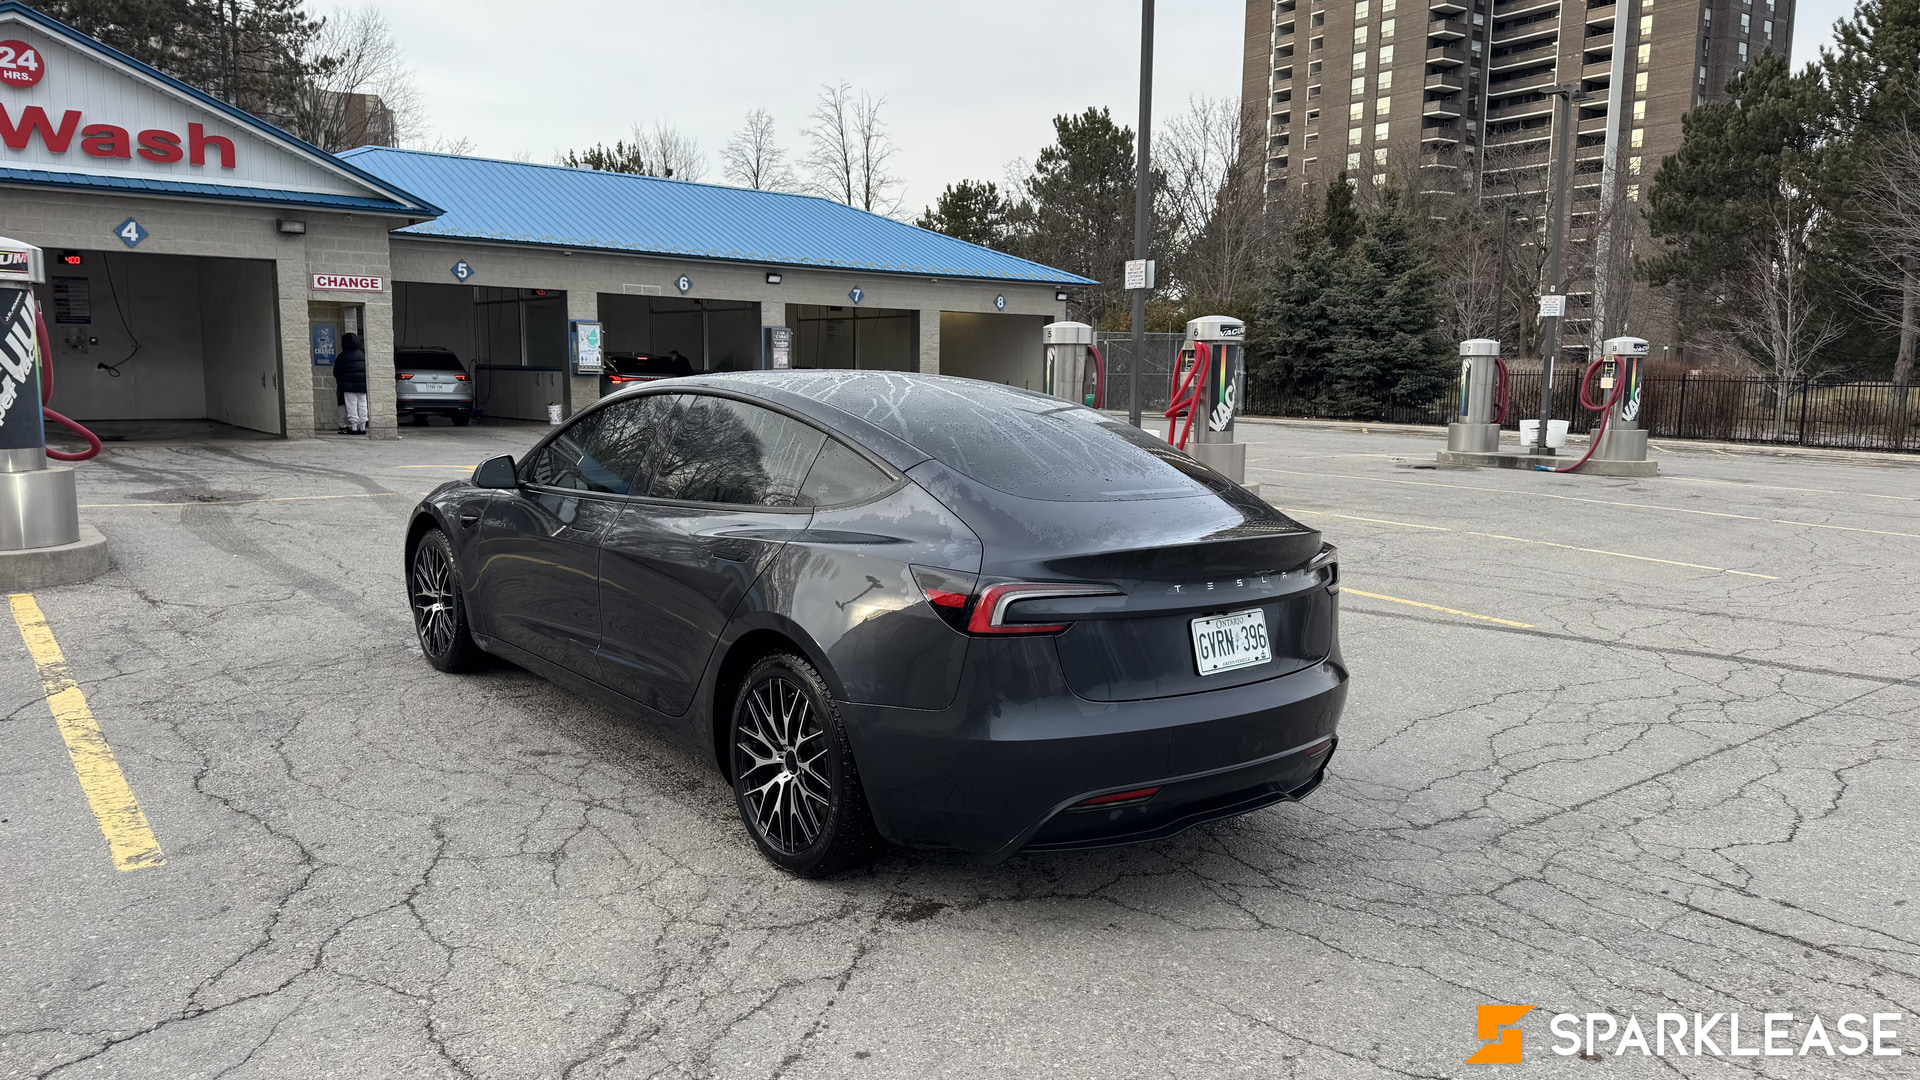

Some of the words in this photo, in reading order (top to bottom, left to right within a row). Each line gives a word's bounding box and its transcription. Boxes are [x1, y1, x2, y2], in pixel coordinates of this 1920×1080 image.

[0, 46, 38, 71] 24
[3, 70, 33, 81] HRS.
[0, 103, 236, 169] Wash
[121, 221, 138, 242] 4
[458, 263, 467, 278] 5
[317, 276, 379, 289] CHANGE
[679, 276, 688, 290] 6
[853, 289, 860, 302] 7
[997, 297, 1004, 308] 8
[1194, 329, 1199, 337] 6
[1174, 572, 1288, 593] TESLA
[1199, 628, 1235, 660] GVRN
[1241, 623, 1267, 651] 396
